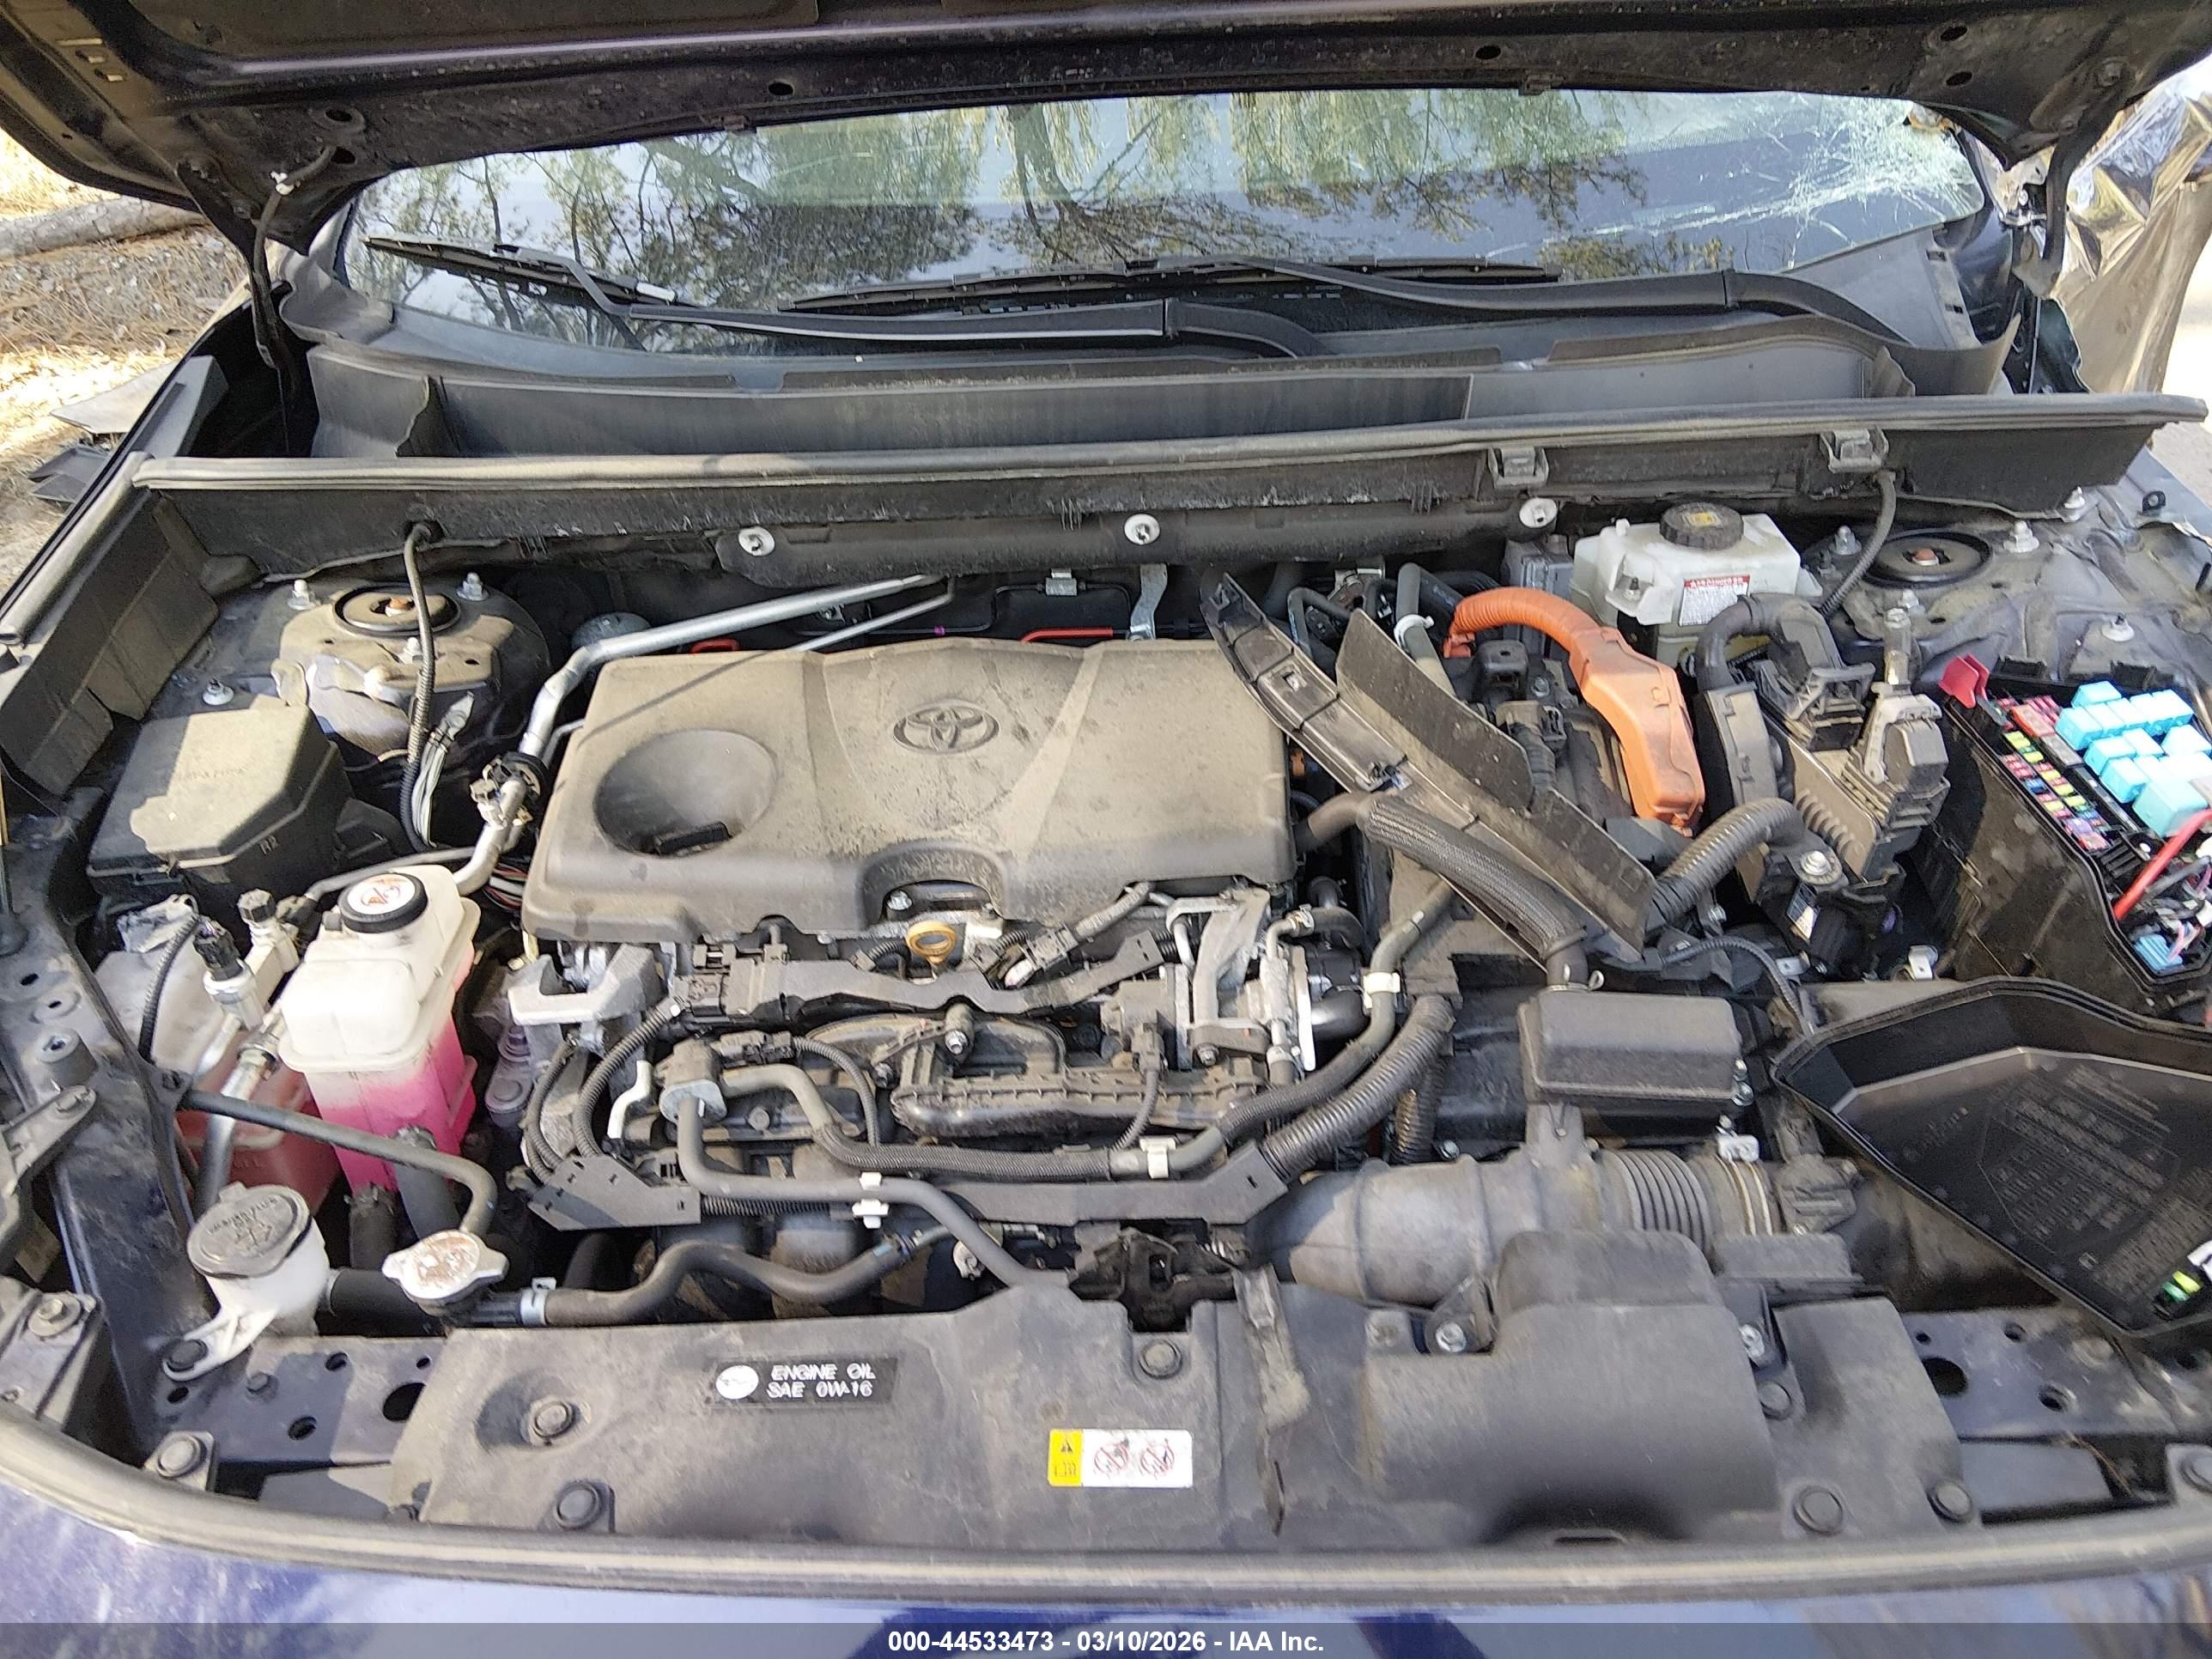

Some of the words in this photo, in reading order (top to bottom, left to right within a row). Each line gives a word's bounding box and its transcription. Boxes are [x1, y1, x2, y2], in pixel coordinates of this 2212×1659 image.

[771, 1364, 837, 1381] ENGINE
[847, 1363, 876, 1380] OIL
[767, 1381, 805, 1398] SAE
